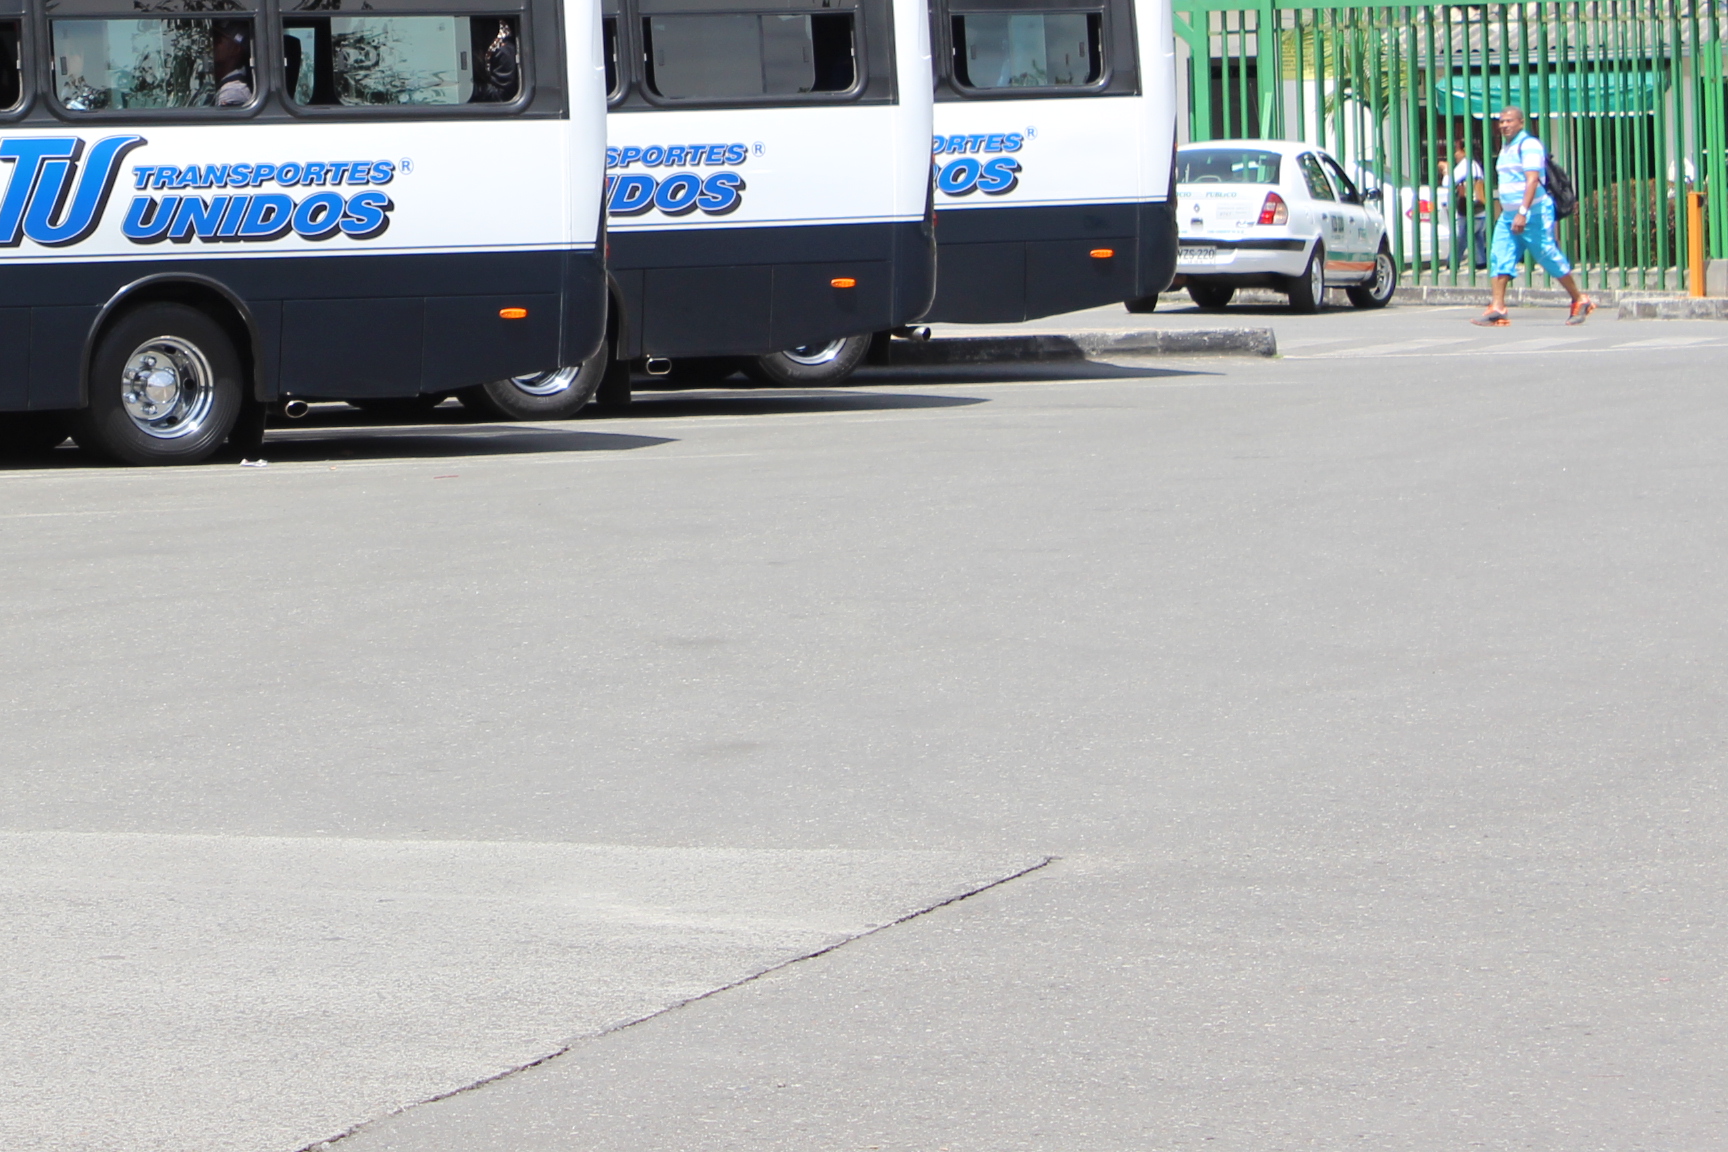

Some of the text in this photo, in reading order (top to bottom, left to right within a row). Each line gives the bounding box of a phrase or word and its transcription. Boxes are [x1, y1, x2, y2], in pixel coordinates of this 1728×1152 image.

[132, 160, 396, 189] TRANSPORTES
[933, 156, 1022, 197] OS
[121, 189, 395, 245] UNIDOS
